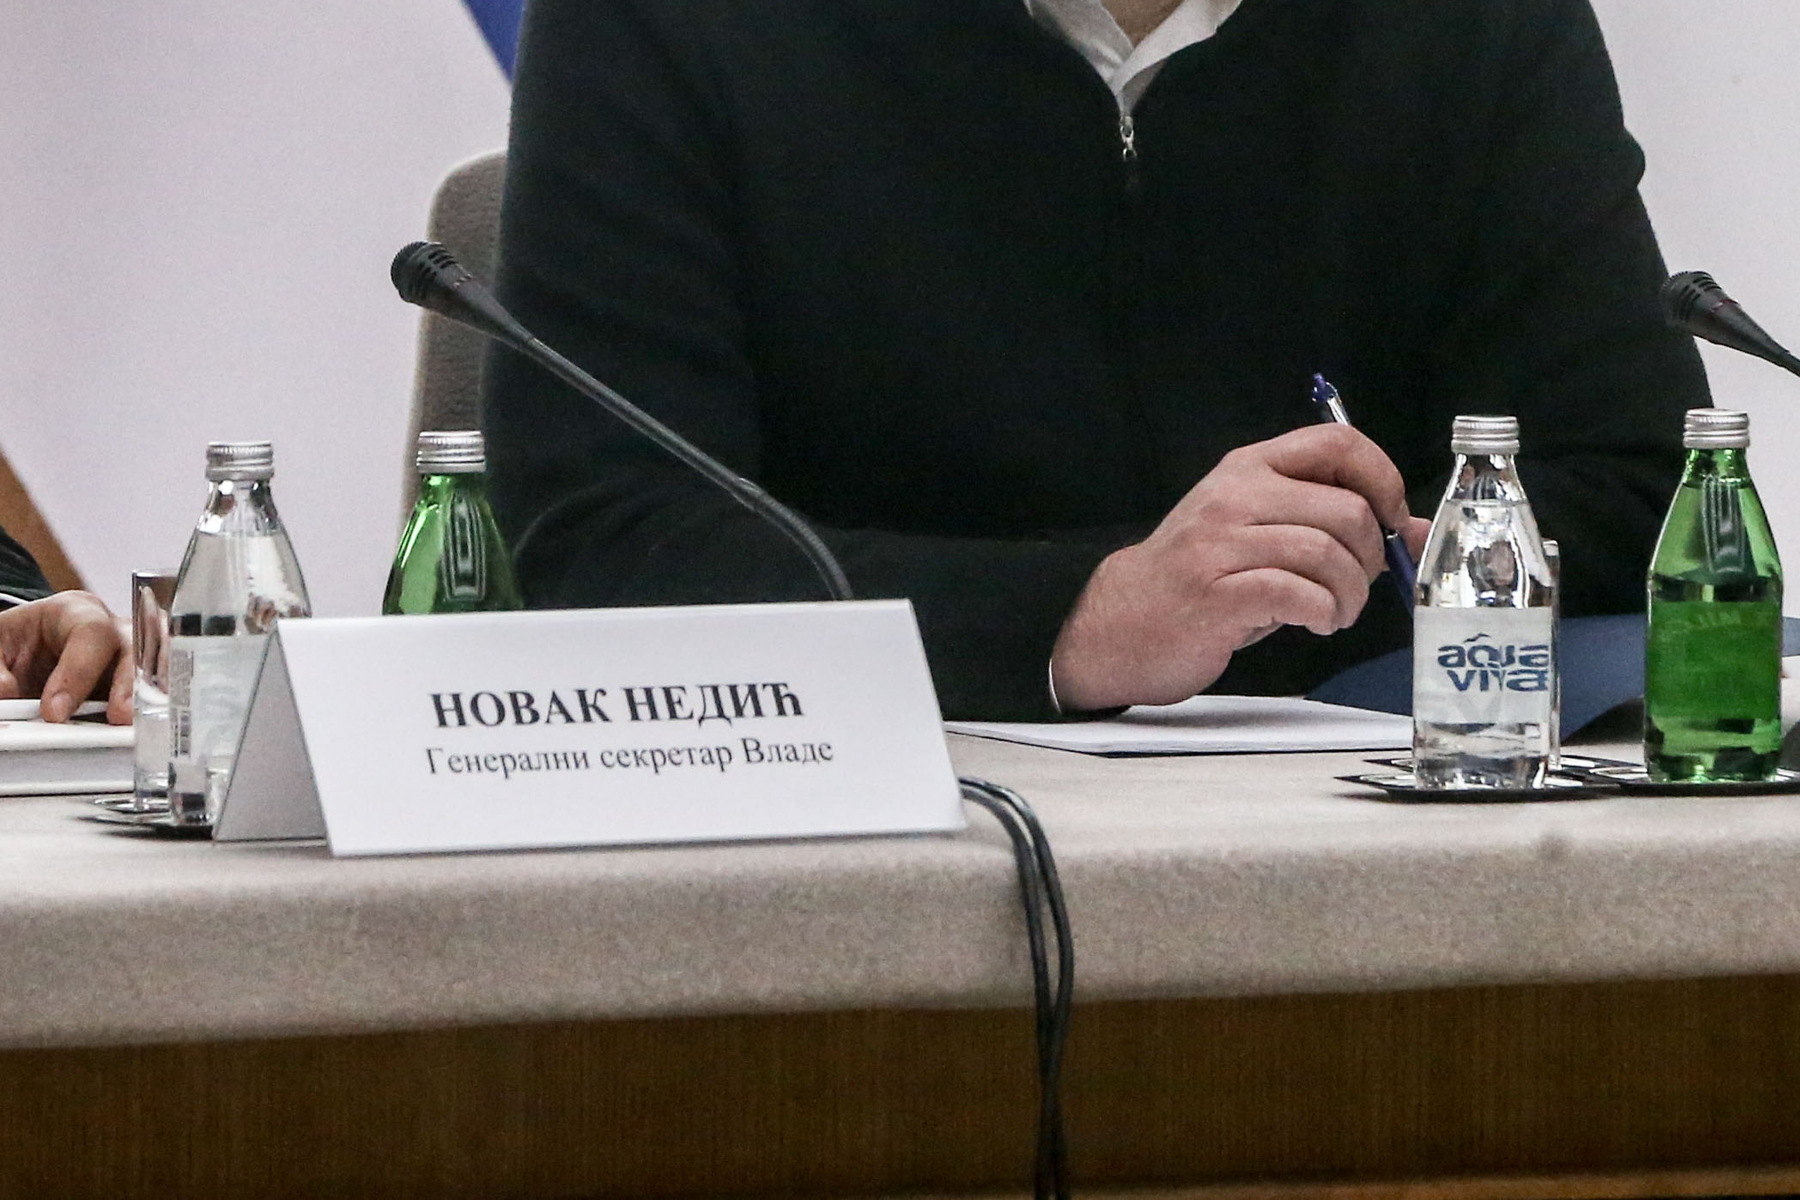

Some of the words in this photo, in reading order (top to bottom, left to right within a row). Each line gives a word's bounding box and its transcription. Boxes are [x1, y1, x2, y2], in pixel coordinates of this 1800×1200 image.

[1437, 644, 1549, 668] aqua
[429, 688, 612, 728] НОВАК
[620, 682, 805, 727] НЕДИЋ
[425, 748, 590, 779] Генерални
[599, 745, 733, 774] секретар
[740, 737, 834, 764] Владе
